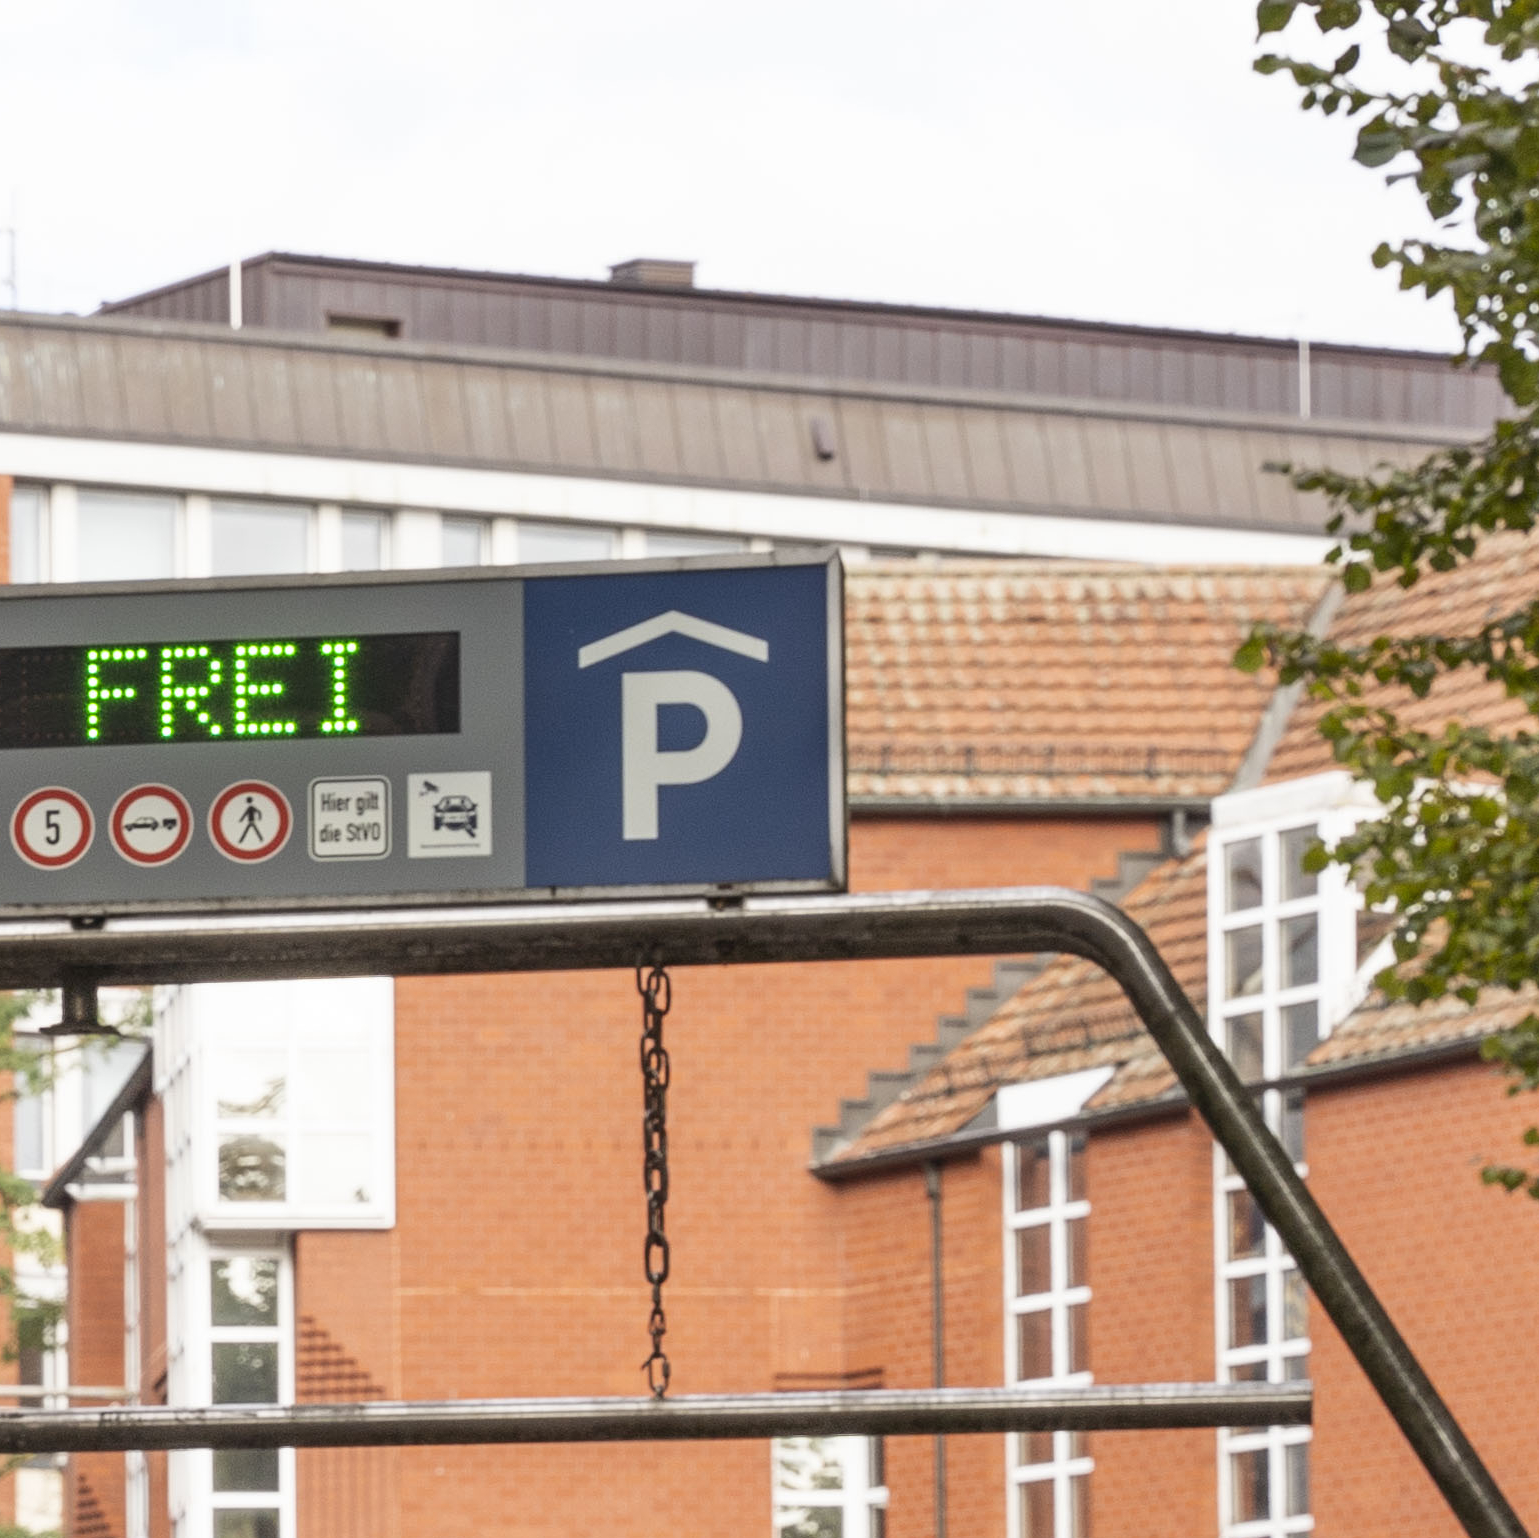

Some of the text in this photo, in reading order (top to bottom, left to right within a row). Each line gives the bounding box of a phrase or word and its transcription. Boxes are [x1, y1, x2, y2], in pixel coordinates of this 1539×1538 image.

[85, 640, 360, 740] FREI
[621, 668, 744, 841] P
[321, 790, 380, 816] Hier gilt
[45, 809, 61, 846] 5
[319, 821, 382, 843] die StVO
